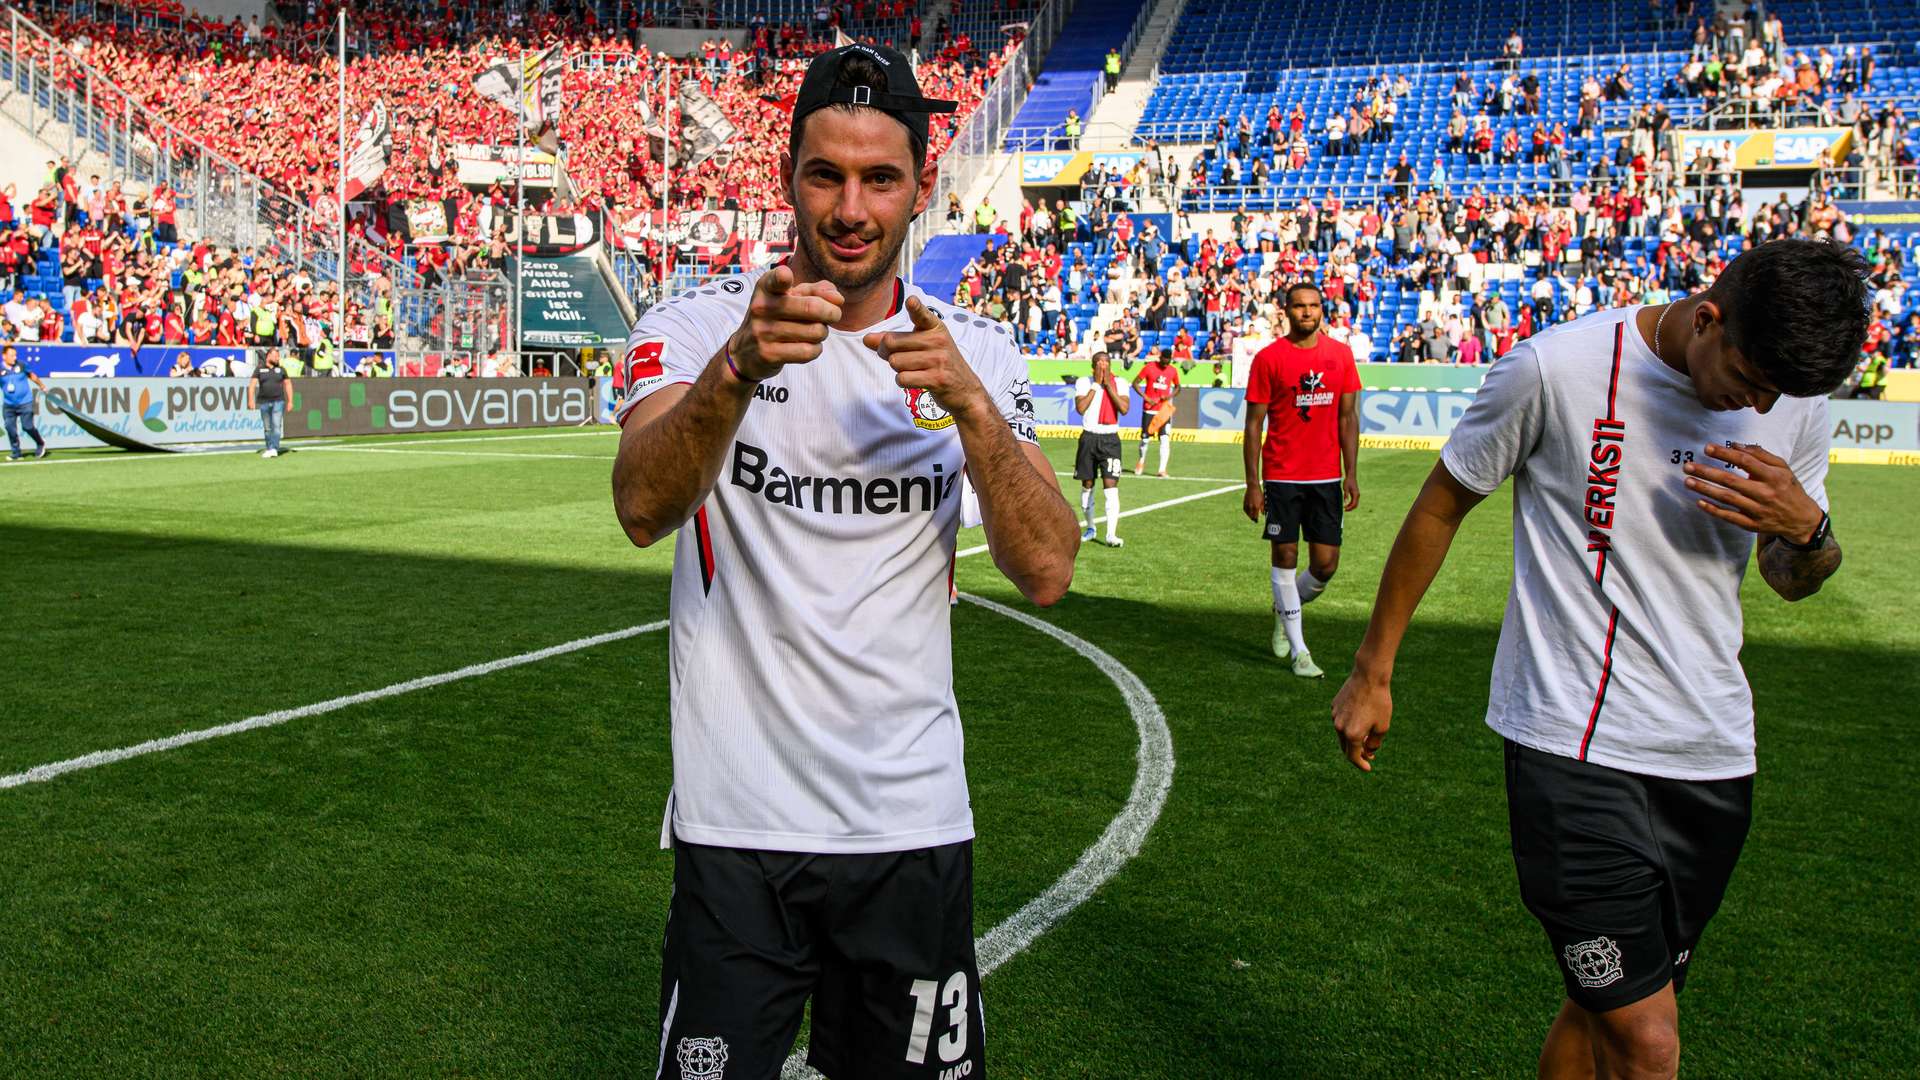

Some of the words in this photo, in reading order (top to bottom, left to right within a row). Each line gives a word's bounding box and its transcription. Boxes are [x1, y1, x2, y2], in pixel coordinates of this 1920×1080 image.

[1775, 138, 1829, 160] SAP
[1023, 158, 1065, 178] SAP
[522, 261, 559, 270] Zero
[525, 289, 583, 298] andere
[531, 279, 570, 288] Alles
[752, 383, 789, 404] AKO
[388, 381, 585, 428] sovanta
[1362, 393, 1474, 436] SAP
[173, 413, 263, 434] internationa
[916, 418, 953, 428] Leverkuse
[1832, 418, 1894, 445] App
[1359, 437, 1431, 449] nterwetten
[1670, 449, 1694, 465] 33
[1582, 971, 1620, 986] Leverkusen
[905, 970, 968, 1065] 13
